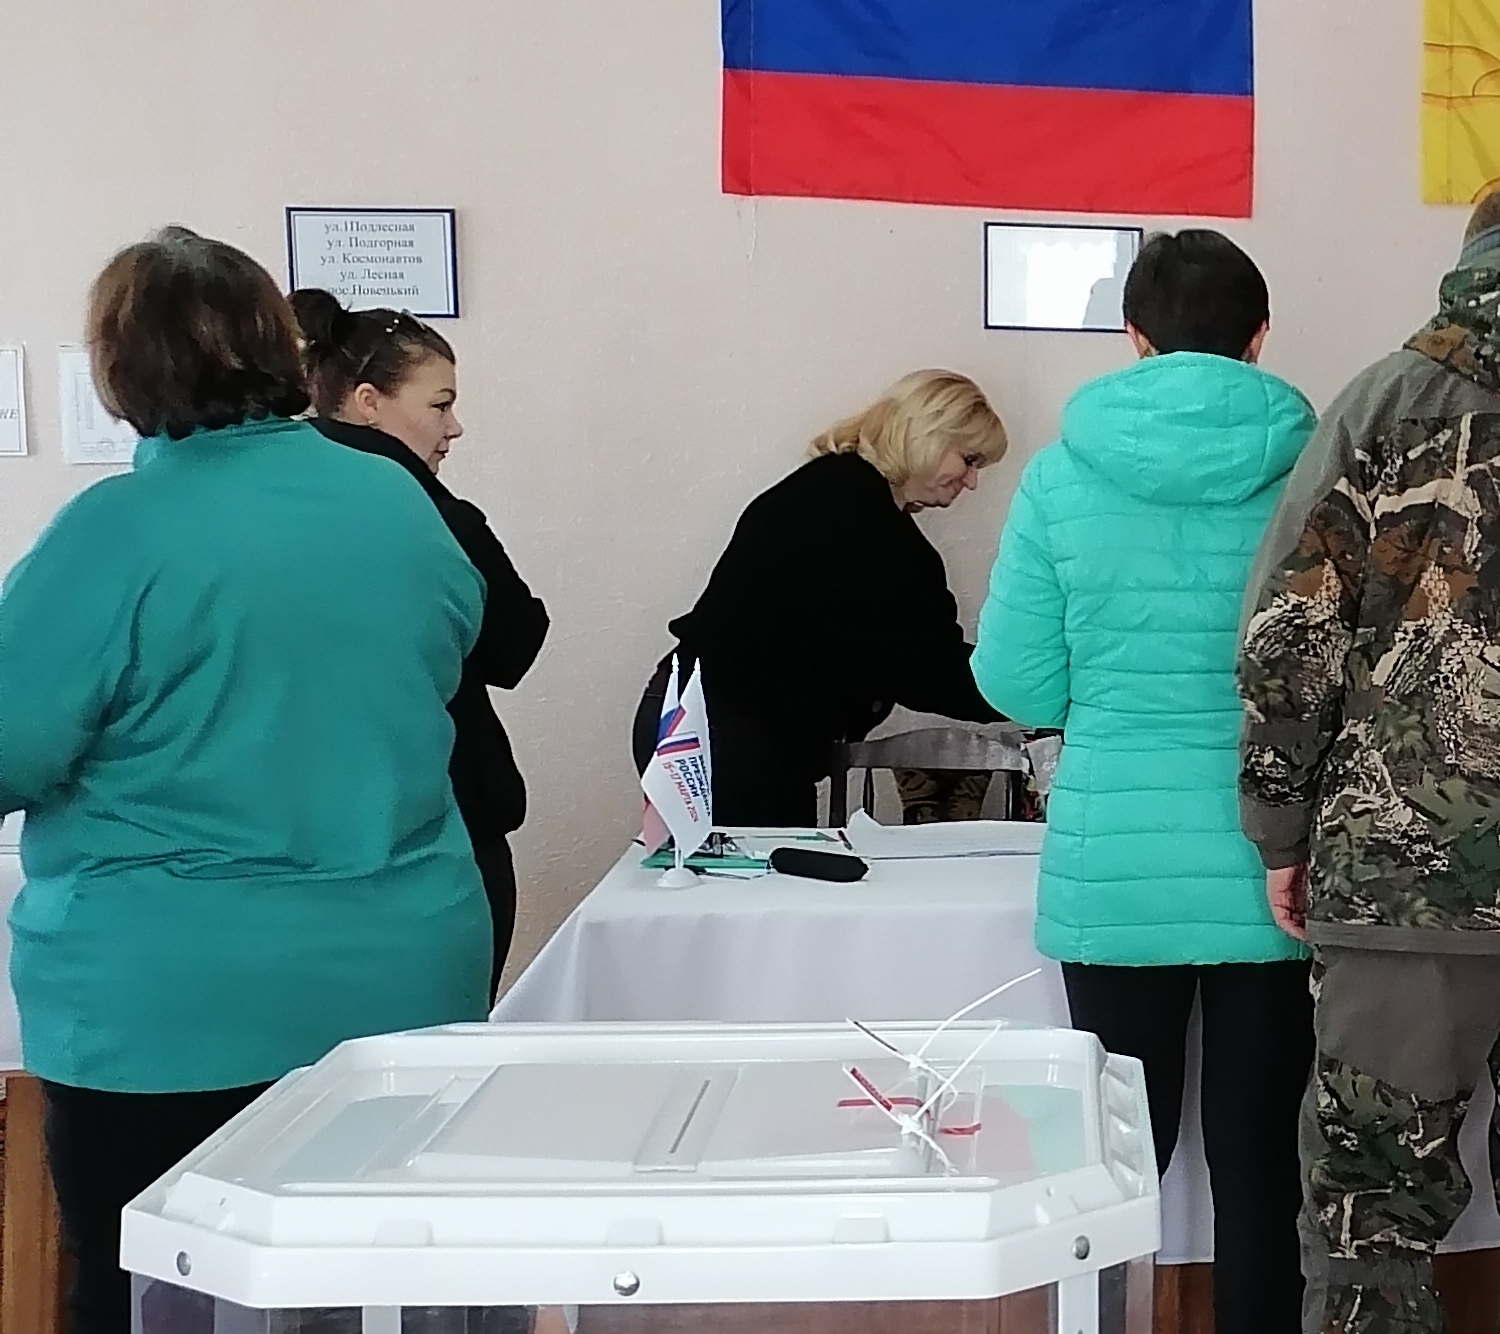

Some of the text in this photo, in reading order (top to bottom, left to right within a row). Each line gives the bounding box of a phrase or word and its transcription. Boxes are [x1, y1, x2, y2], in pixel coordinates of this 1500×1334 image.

[349, 236, 415, 252] Подгорная
[342, 252, 423, 264] Космонавтов
[361, 268, 405, 280] Лесная
